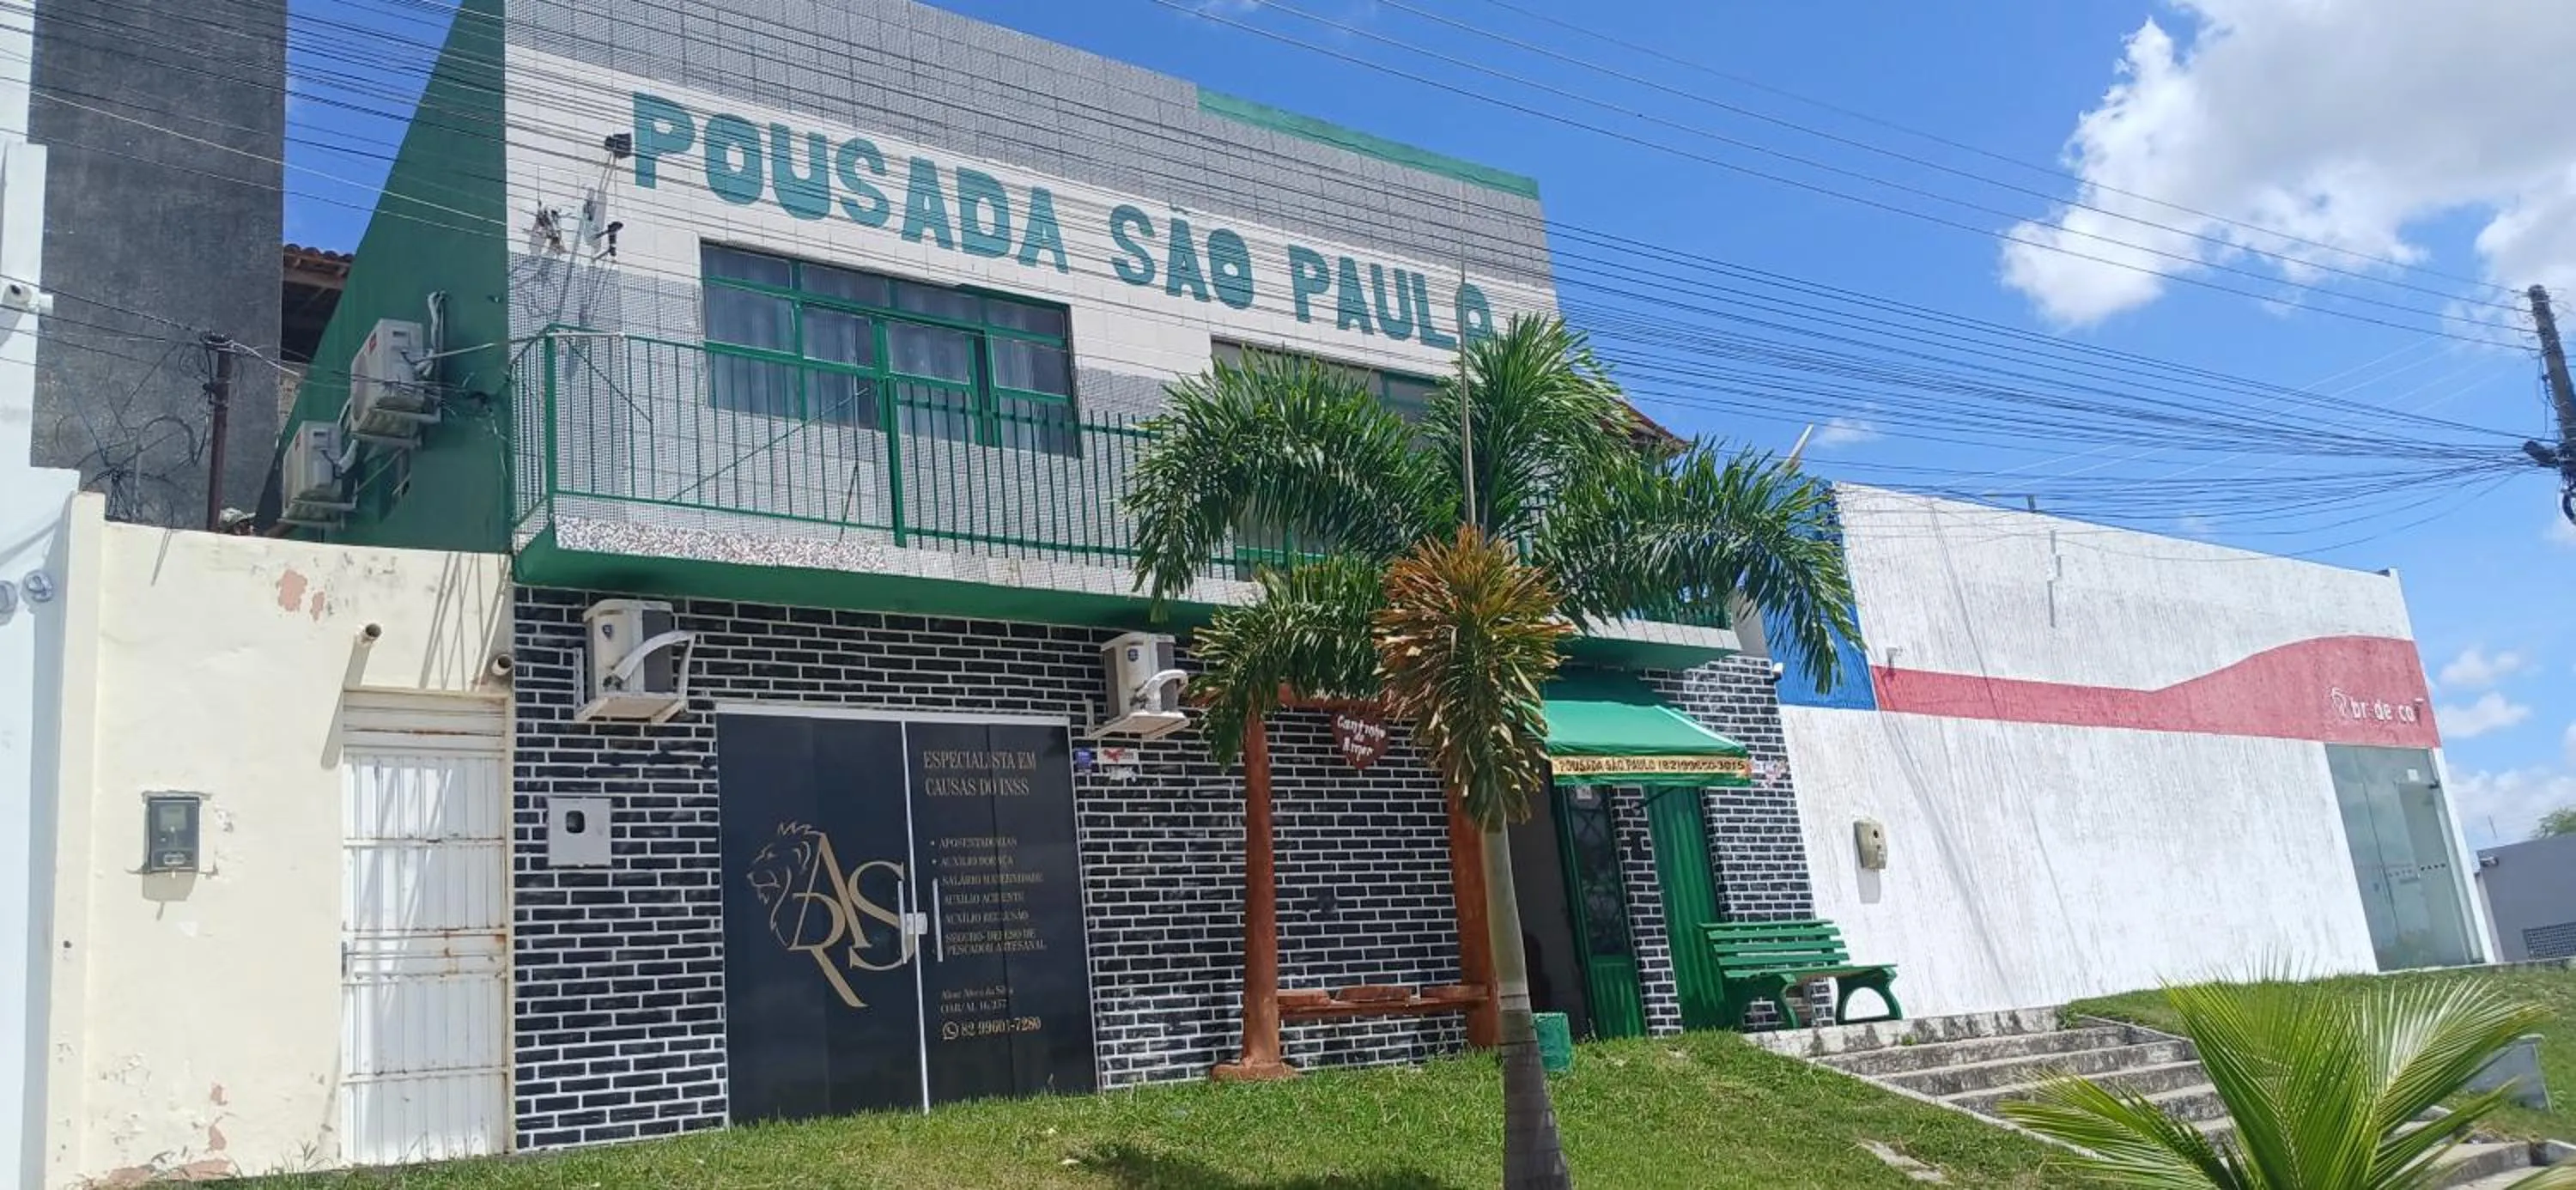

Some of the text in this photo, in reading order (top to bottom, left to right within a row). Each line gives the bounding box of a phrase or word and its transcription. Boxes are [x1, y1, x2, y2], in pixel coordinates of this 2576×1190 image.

[633, 92, 1494, 350] POUSADA SÃO PAULO
[1018, 750, 1036, 770] EM
[1558, 759, 1603, 772] POUSADA
[925, 777, 1030, 796] CAUSAS DO INSS
[961, 1020, 976, 1036] 82
